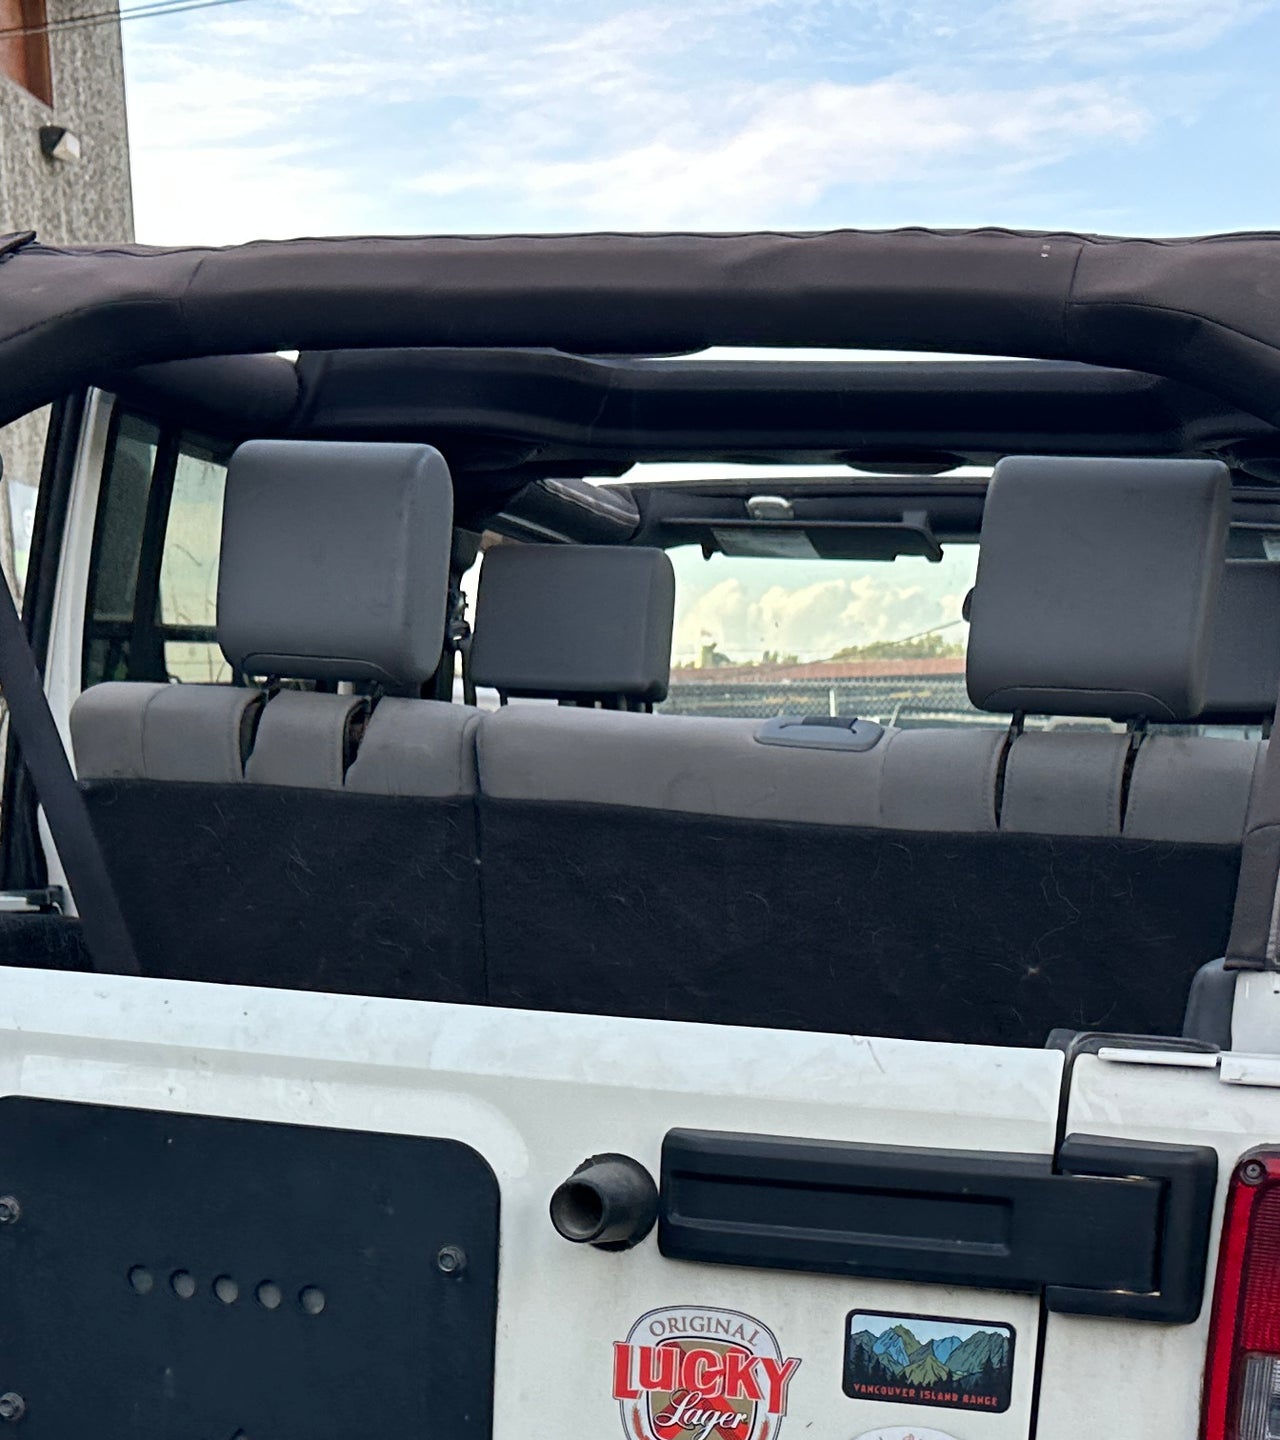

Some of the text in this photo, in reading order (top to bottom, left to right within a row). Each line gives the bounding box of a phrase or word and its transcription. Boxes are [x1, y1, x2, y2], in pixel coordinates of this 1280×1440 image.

[649, 1316, 762, 1347] ORIGINAL
[612, 1341, 802, 1417] LUCKY
[853, 1383, 999, 1407] VANCOUVER ISLAND RANGE
